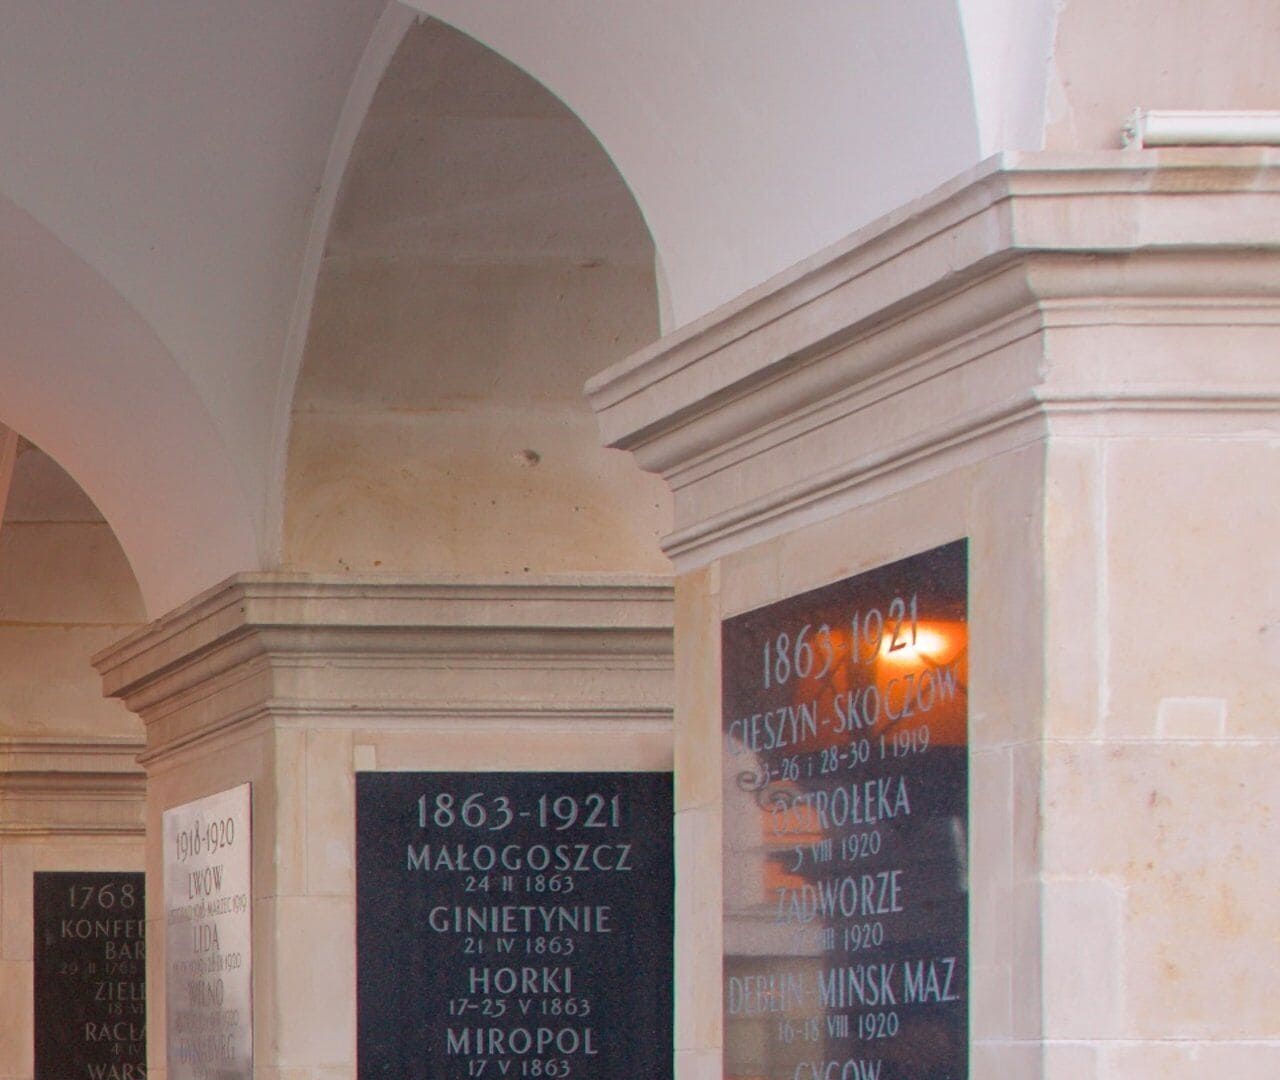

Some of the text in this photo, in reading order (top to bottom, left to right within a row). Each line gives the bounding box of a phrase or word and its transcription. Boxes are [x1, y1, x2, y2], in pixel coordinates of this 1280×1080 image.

[892, 725, 930, 758] 1919
[417, 793, 620, 831] 1863-1921
[408, 845, 632, 871] MAŁOGOSZCZ
[842, 831, 880, 861] 1920
[465, 876, 574, 893] 24 1863
[429, 906, 611, 933] GINIETYNIE
[526, 938, 574, 954] 1863
[845, 922, 883, 951] 1920
[470, 968, 571, 994] HORKI
[450, 999, 590, 1017] 17-25 1863
[827, 1015, 848, 1038] VIII
[859, 1012, 899, 1041] 1920
[447, 1028, 597, 1054] MIROPOL
[522, 1060, 570, 1077] 1863
